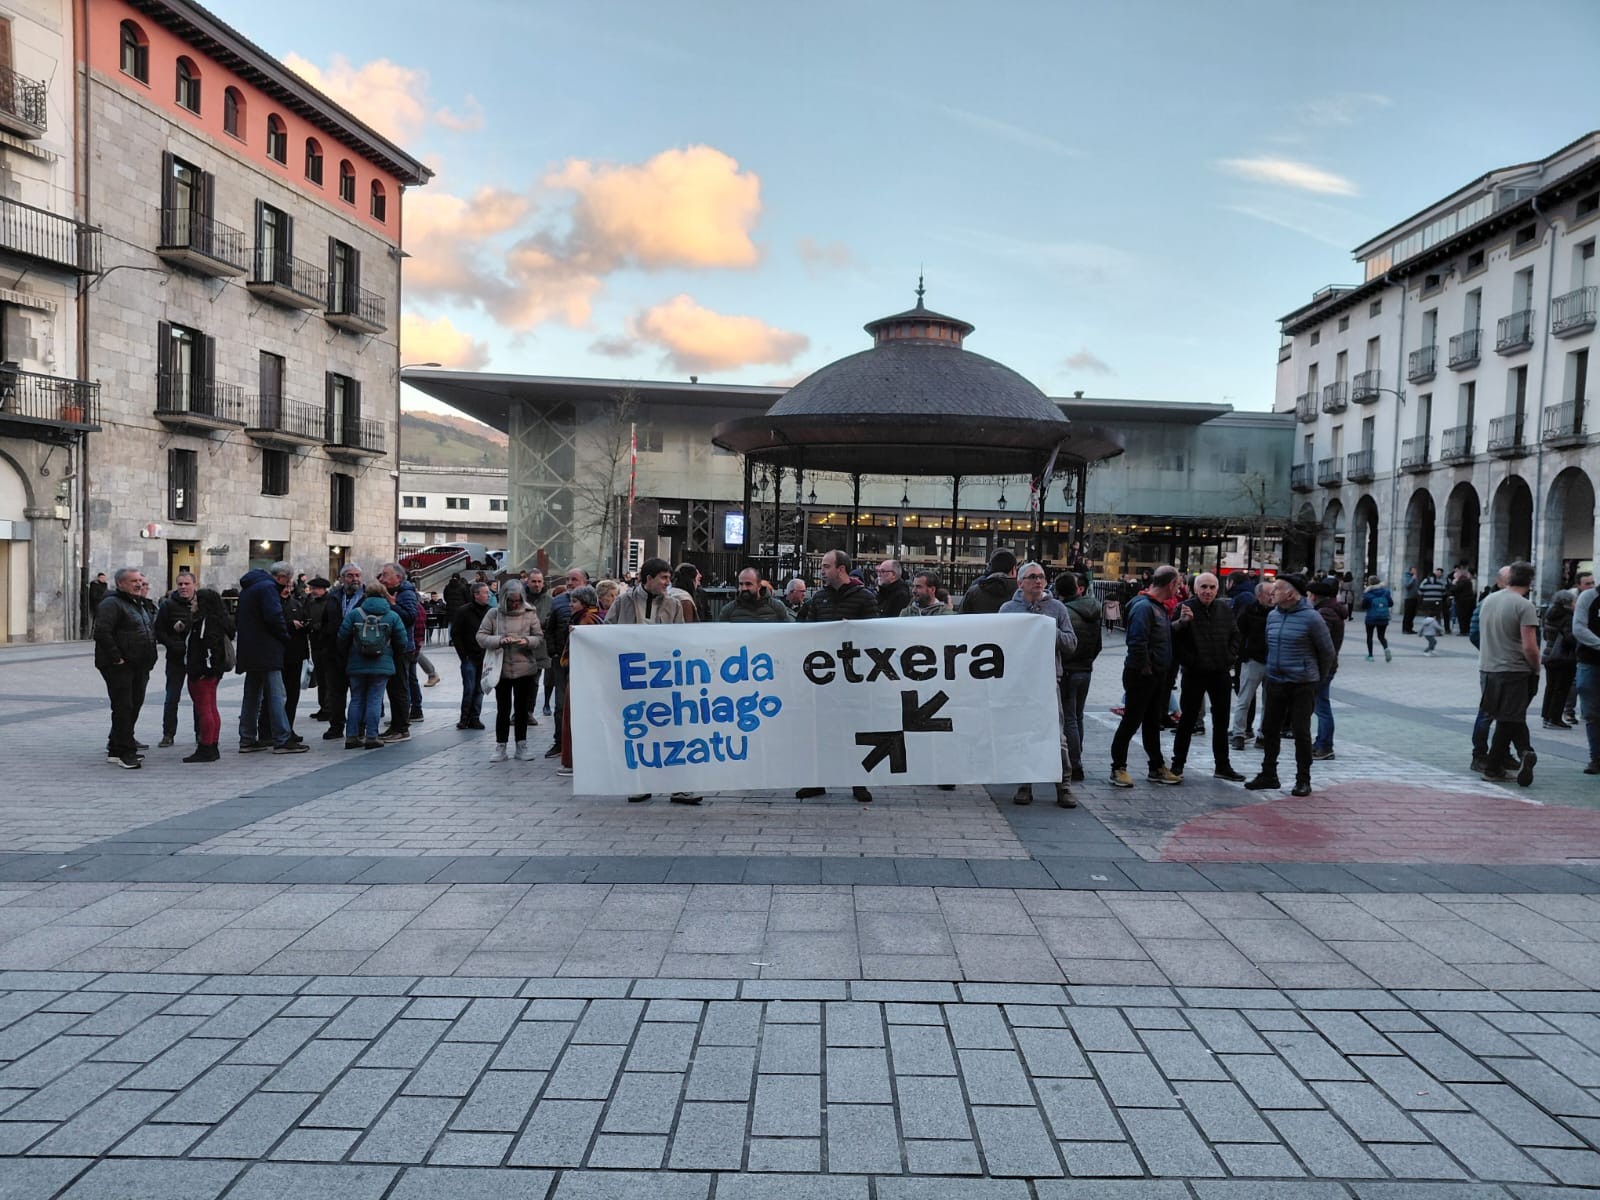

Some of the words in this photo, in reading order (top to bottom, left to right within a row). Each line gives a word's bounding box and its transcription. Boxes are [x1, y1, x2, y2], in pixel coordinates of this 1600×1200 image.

[618, 648, 712, 690] Ezin
[720, 644, 775, 685] da
[803, 641, 1004, 685] etxera
[622, 687, 783, 740] gehiago
[624, 731, 749, 770] luzatu
